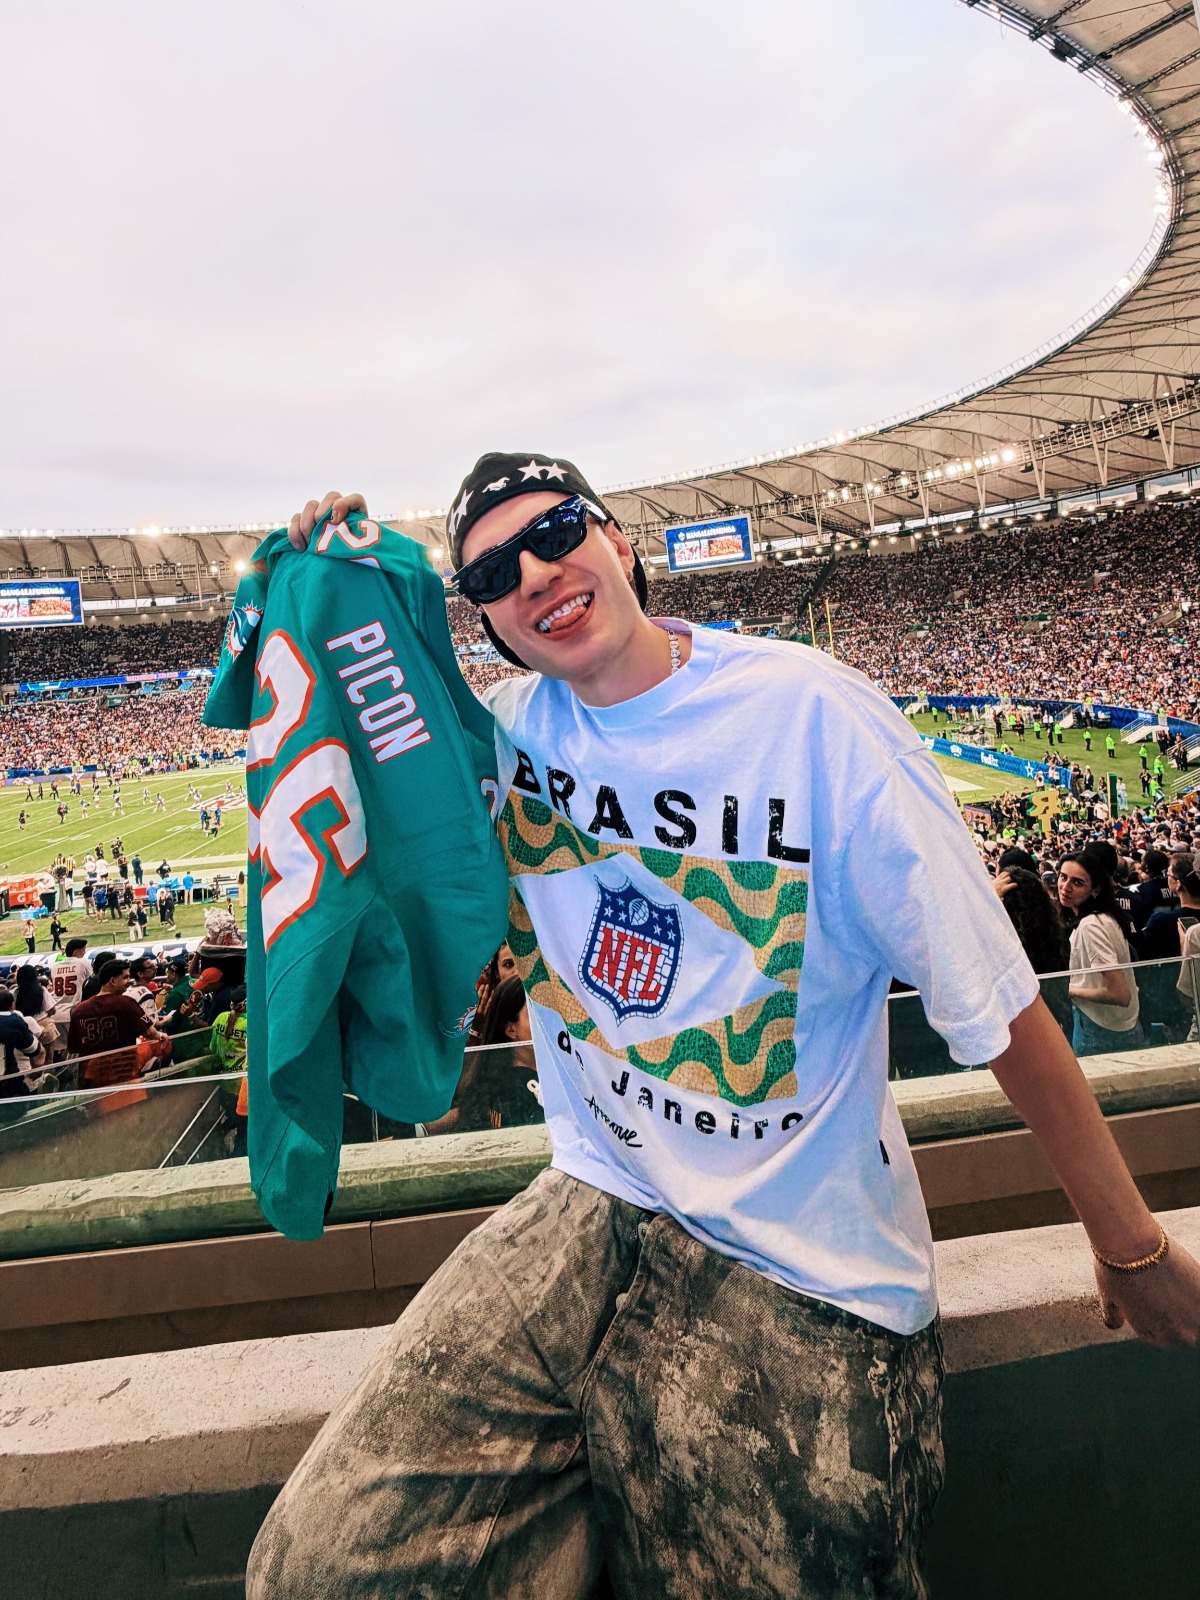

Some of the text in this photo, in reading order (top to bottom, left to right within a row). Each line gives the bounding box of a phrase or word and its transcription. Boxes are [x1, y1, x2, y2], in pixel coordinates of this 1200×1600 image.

[326, 620, 432, 764] PICON
[512, 745, 811, 864] BRASIL
[54, 975, 77, 996] 85
[591, 926, 675, 1003] NFL
[611, 1071, 803, 1139] Janeiro
